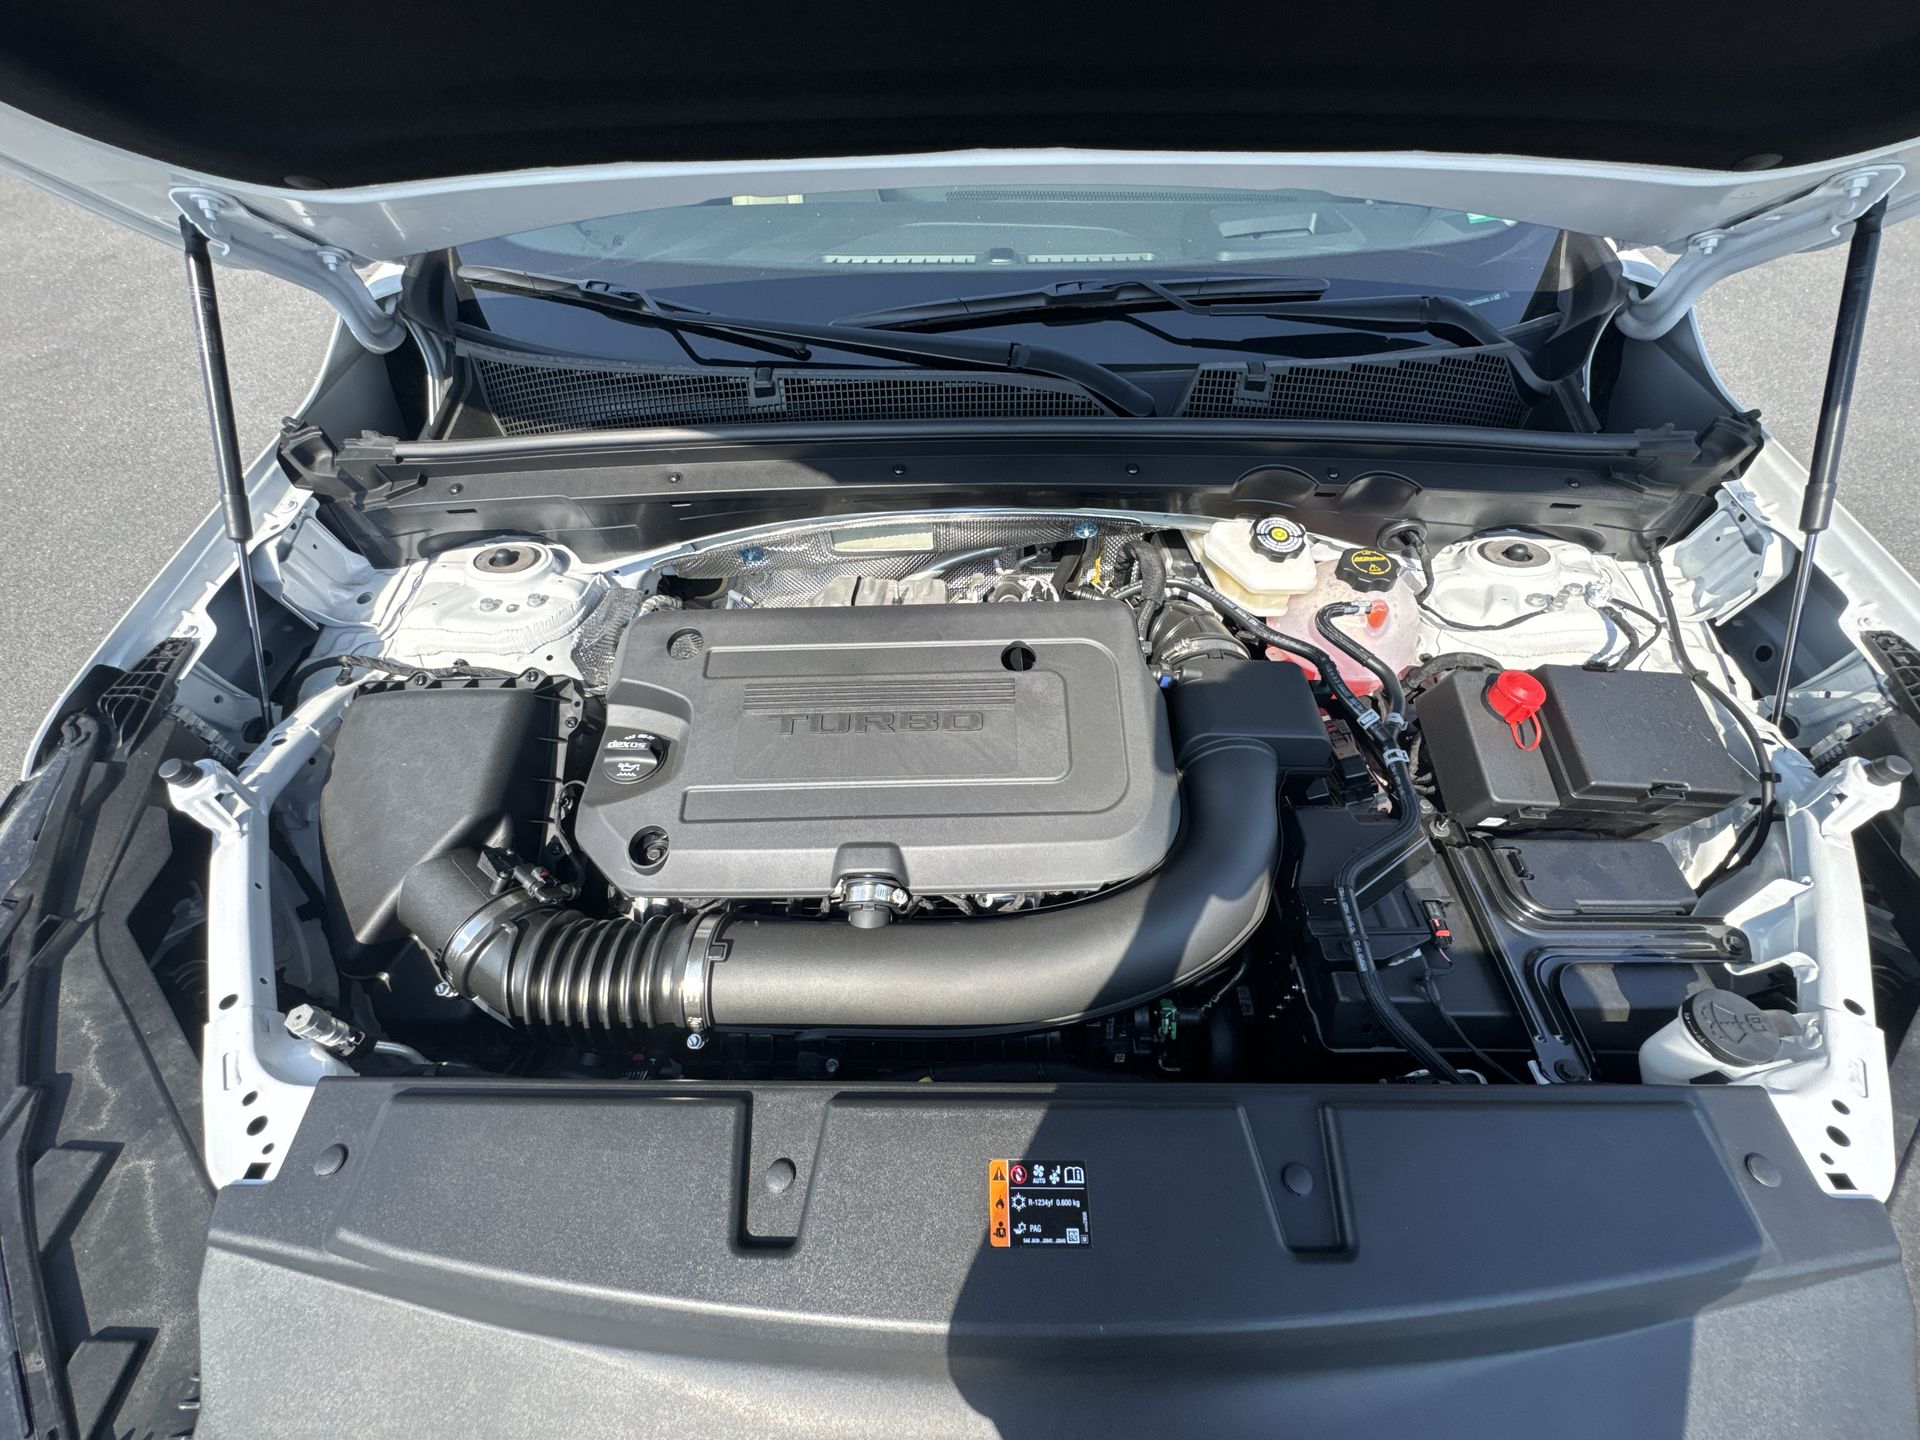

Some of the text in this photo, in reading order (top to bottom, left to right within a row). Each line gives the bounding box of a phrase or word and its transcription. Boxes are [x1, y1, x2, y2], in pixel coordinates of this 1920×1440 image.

[768, 711, 984, 736] TURBO
[606, 740, 647, 749] dexos
[1028, 1199, 1053, 1207] R-1234yf
[1073, 1199, 1080, 1207] kg
[1029, 1224, 1042, 1233] PAG
